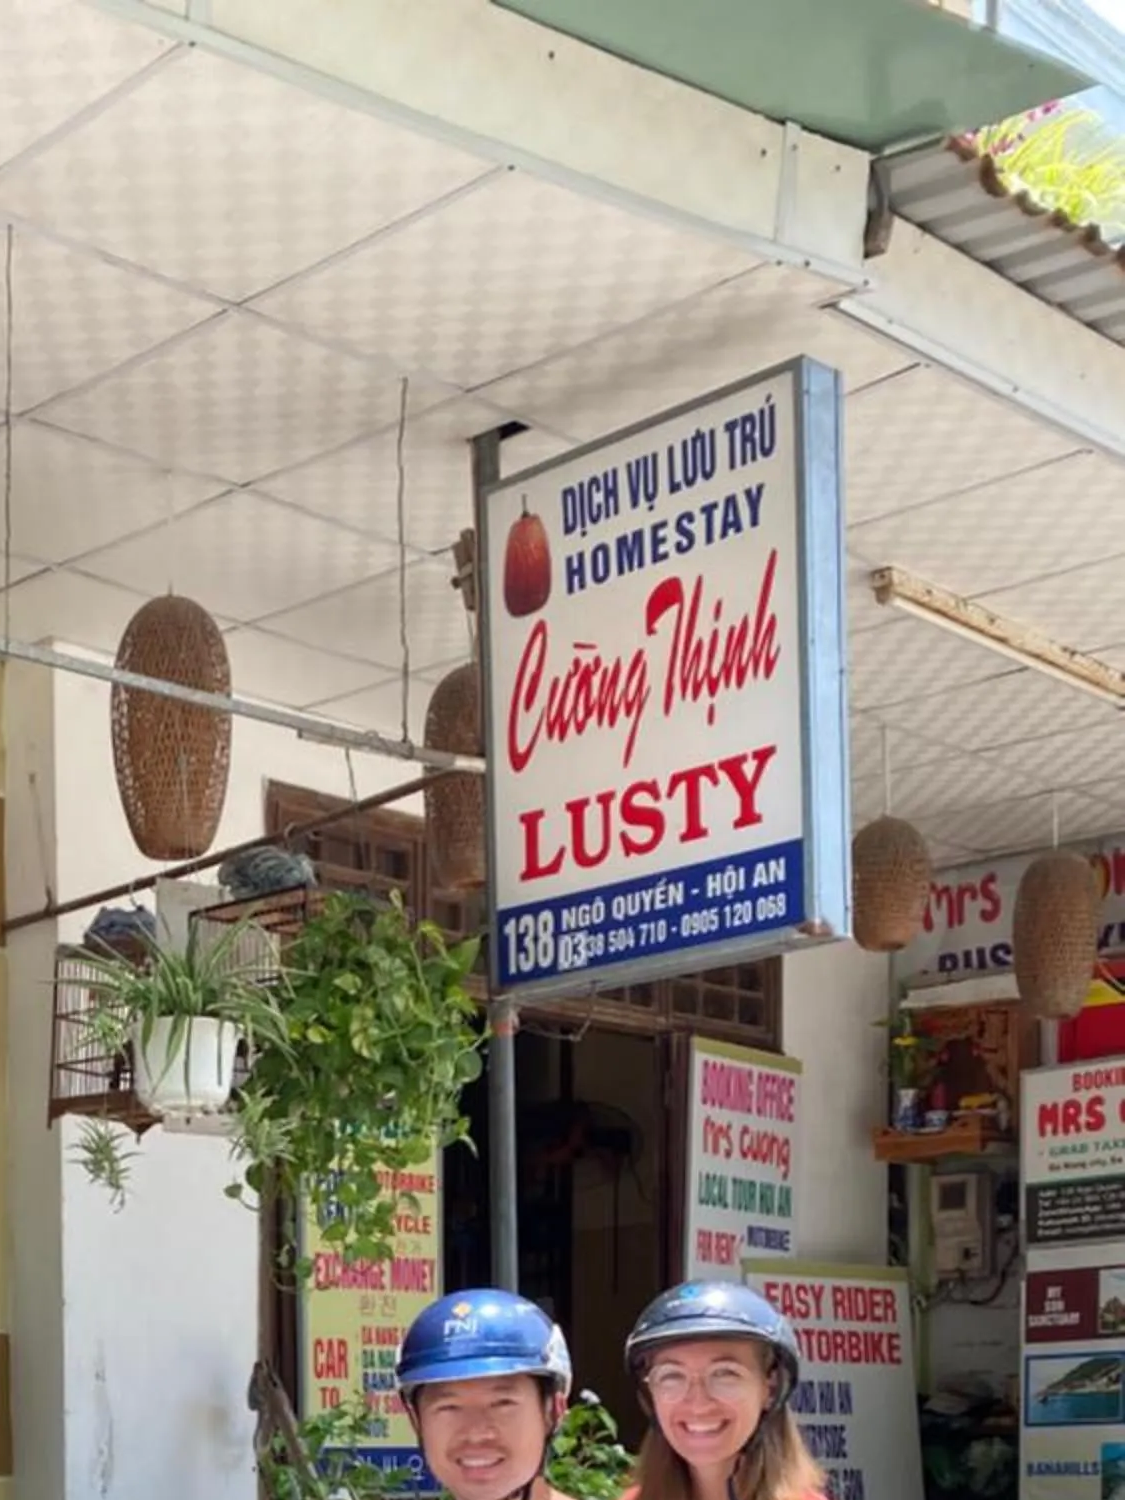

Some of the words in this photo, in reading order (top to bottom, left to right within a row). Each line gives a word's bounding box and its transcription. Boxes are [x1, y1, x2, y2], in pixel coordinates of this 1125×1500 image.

[561, 466, 621, 538] DỊCH
[626, 451, 660, 513] VỤ
[667, 428, 717, 495] LƯU
[724, 392, 777, 471] TRÚ
[565, 482, 766, 596] HOMESTAY
[643, 546, 781, 727] Thịnh
[519, 744, 778, 883] LUSTY
[503, 909, 555, 977] 138
[560, 898, 606, 934] NGÔ
[706, 864, 746, 901] HỘI
[752, 857, 787, 890] AN
[608, 929, 636, 957] 504
[639, 919, 668, 948] 710
[681, 906, 720, 939] 0905
[724, 899, 753, 929] 120
[756, 892, 788, 922] 068
[701, 1060, 753, 1114] BOOKING
[756, 1072, 795, 1123] OFFICE
[1037, 1096, 1105, 1138] MRS
[698, 1171, 729, 1210] LOCAL
[731, 1176, 758, 1214] TOUR
[390, 1257, 436, 1293] MONEY
[764, 1281, 825, 1321] EASY
[832, 1285, 897, 1323] RIDER
[313, 1337, 348, 1380] CAR
[319, 1386, 341, 1410] TO
